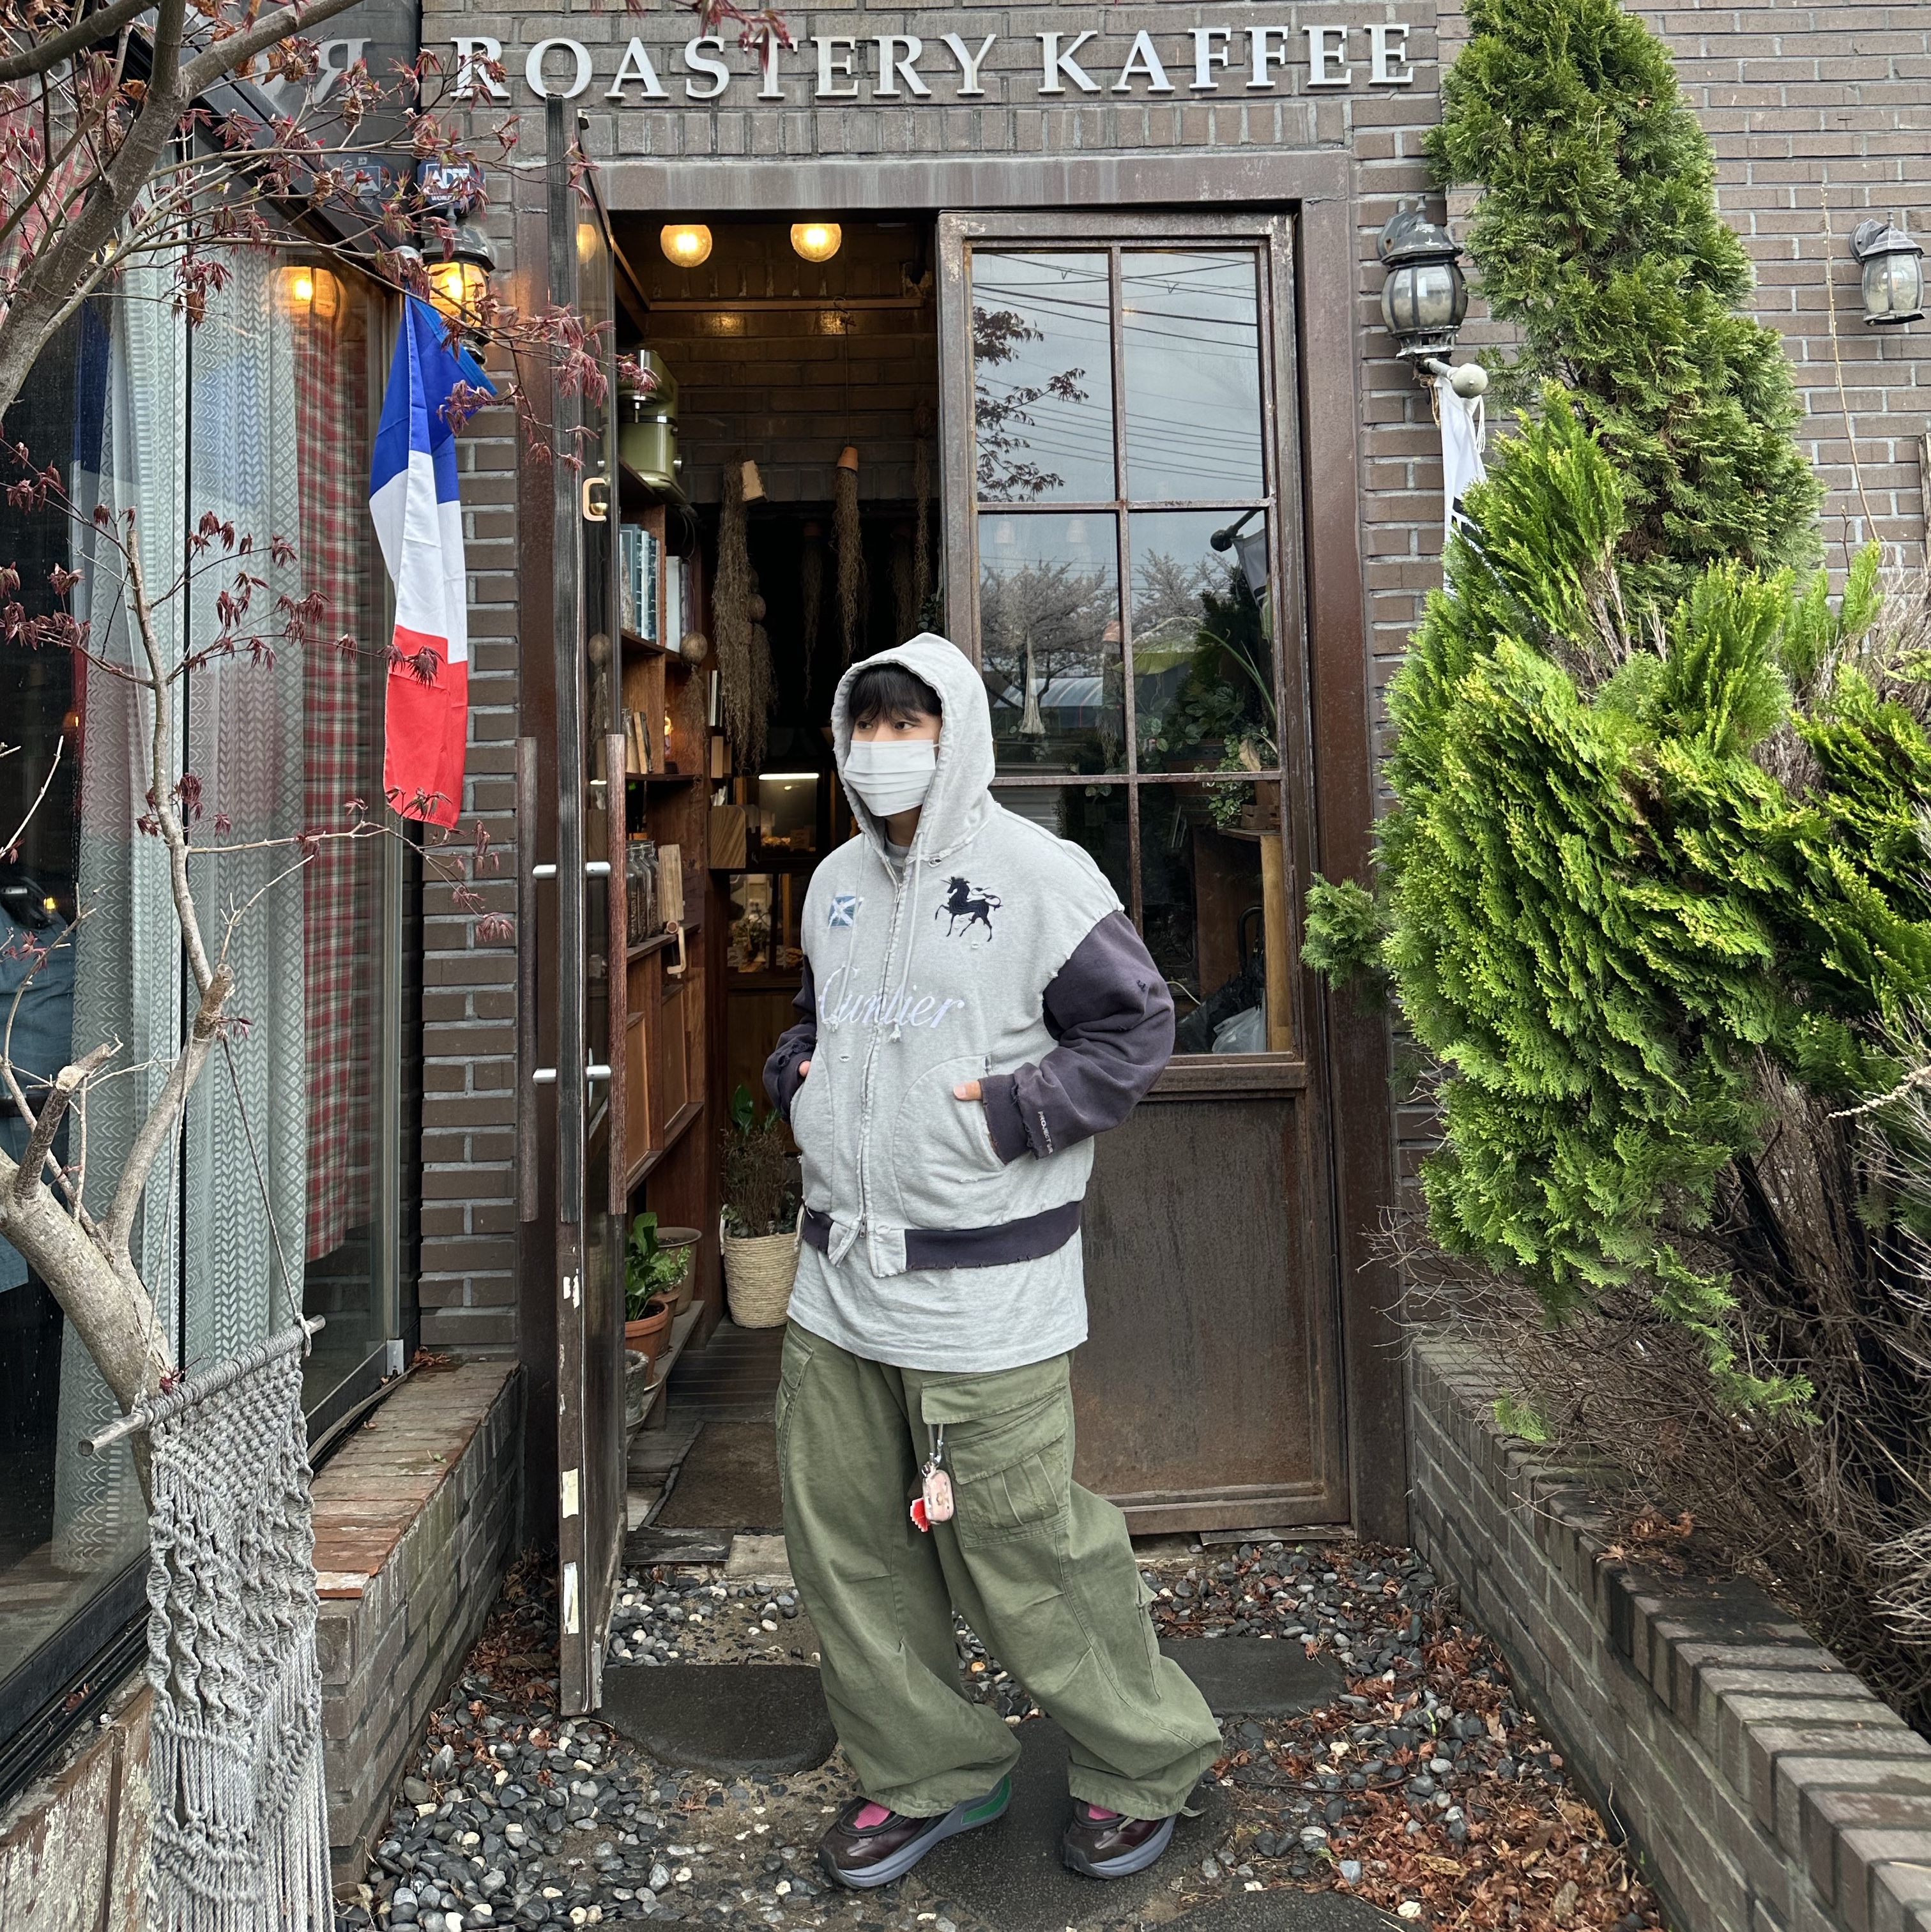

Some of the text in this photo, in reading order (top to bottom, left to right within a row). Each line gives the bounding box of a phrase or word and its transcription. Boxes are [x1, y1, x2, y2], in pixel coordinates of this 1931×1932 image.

[449, 33, 997, 100] ROASTERY
[1035, 23, 1414, 95] KAFFEE
[427, 167, 470, 190] ADT
